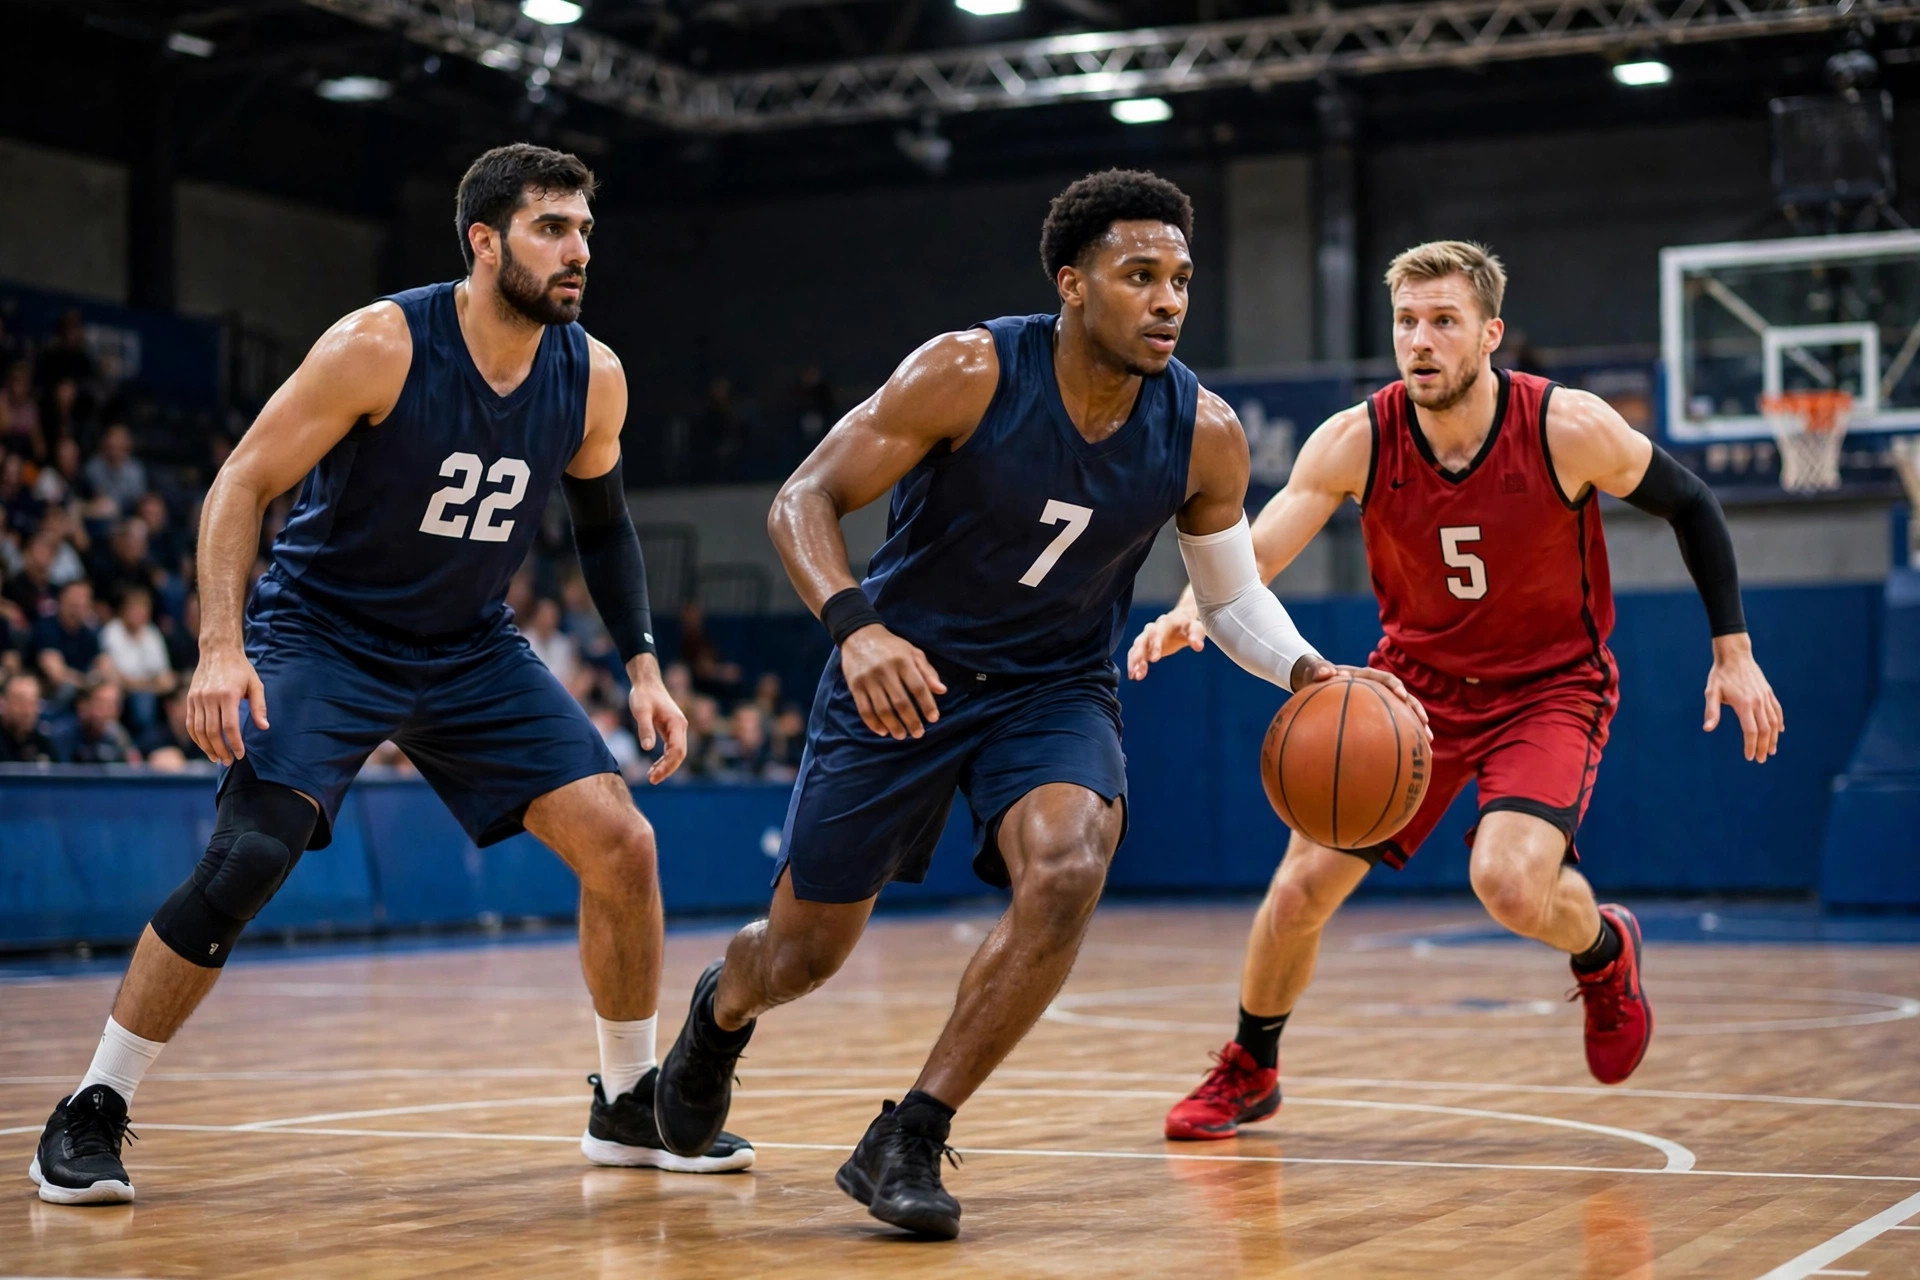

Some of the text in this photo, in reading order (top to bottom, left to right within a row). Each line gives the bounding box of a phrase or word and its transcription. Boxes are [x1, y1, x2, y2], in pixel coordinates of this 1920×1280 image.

[419, 452, 531, 542] 22
[1018, 499, 1094, 588] 7
[1440, 526, 1487, 599] 5
